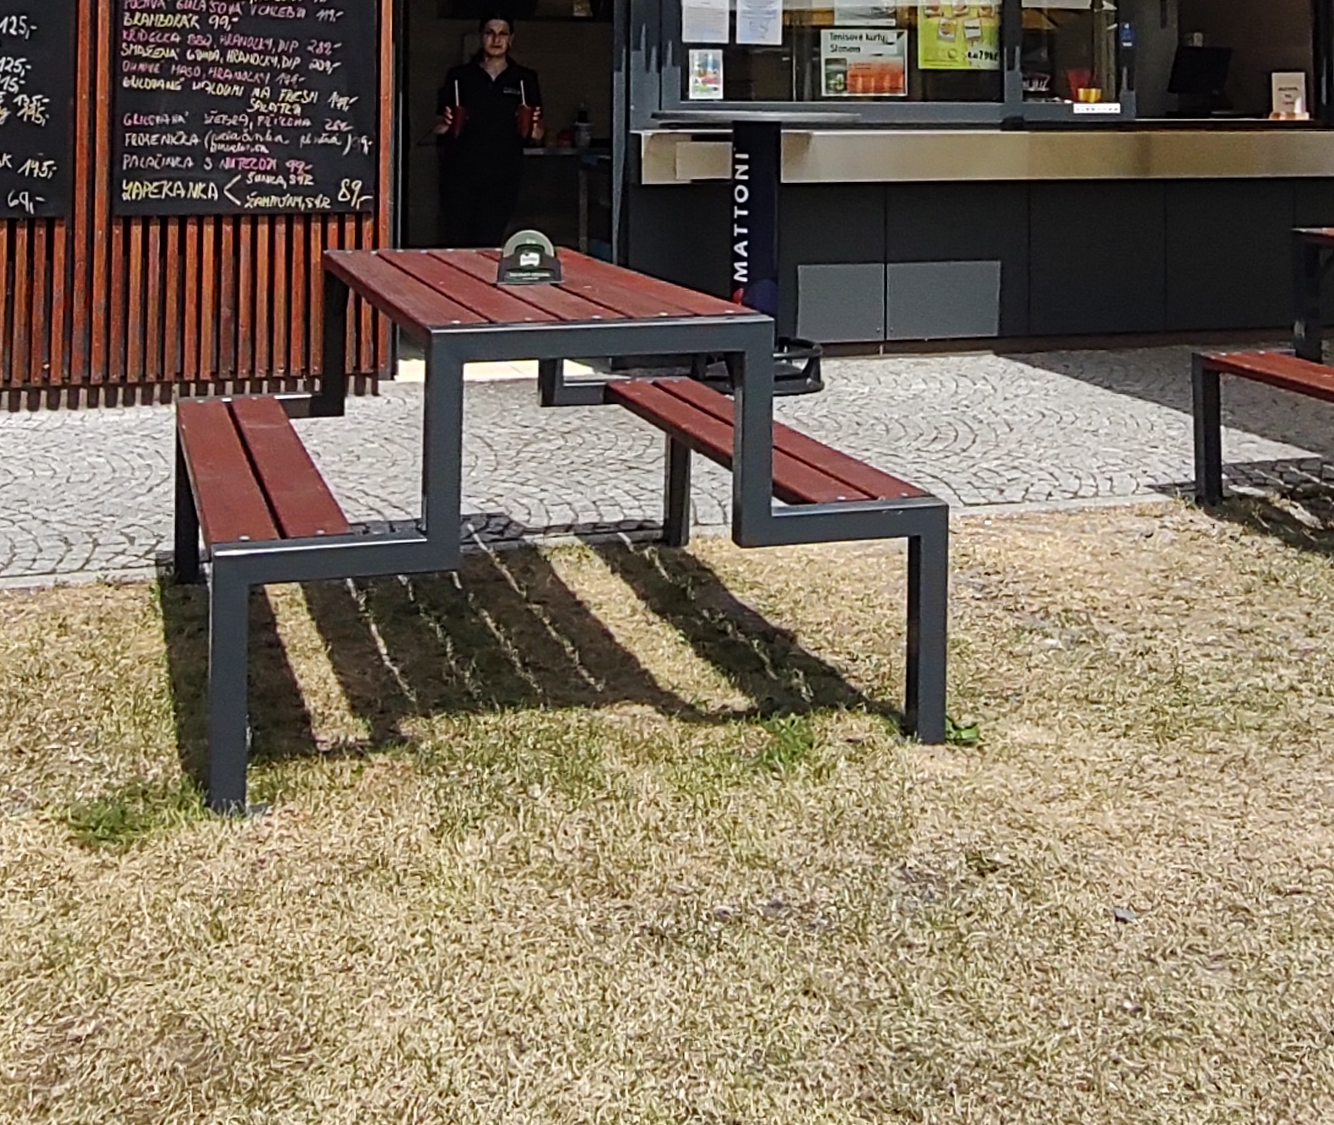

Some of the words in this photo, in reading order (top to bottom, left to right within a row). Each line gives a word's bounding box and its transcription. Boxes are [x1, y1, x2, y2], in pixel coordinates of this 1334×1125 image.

[123, 12, 201, 30] BRAMBORÁK
[208, 15, 240, 31] 99,-
[277, 38, 300, 53] DIP
[281, 55, 302, 71] DIP
[251, 86, 271, 99] NA
[278, 88, 319, 103] FRESH
[203, 157, 213, 171] S
[7, 189, 46, 215] 69,-
[733, 152, 750, 283] MATTONI
